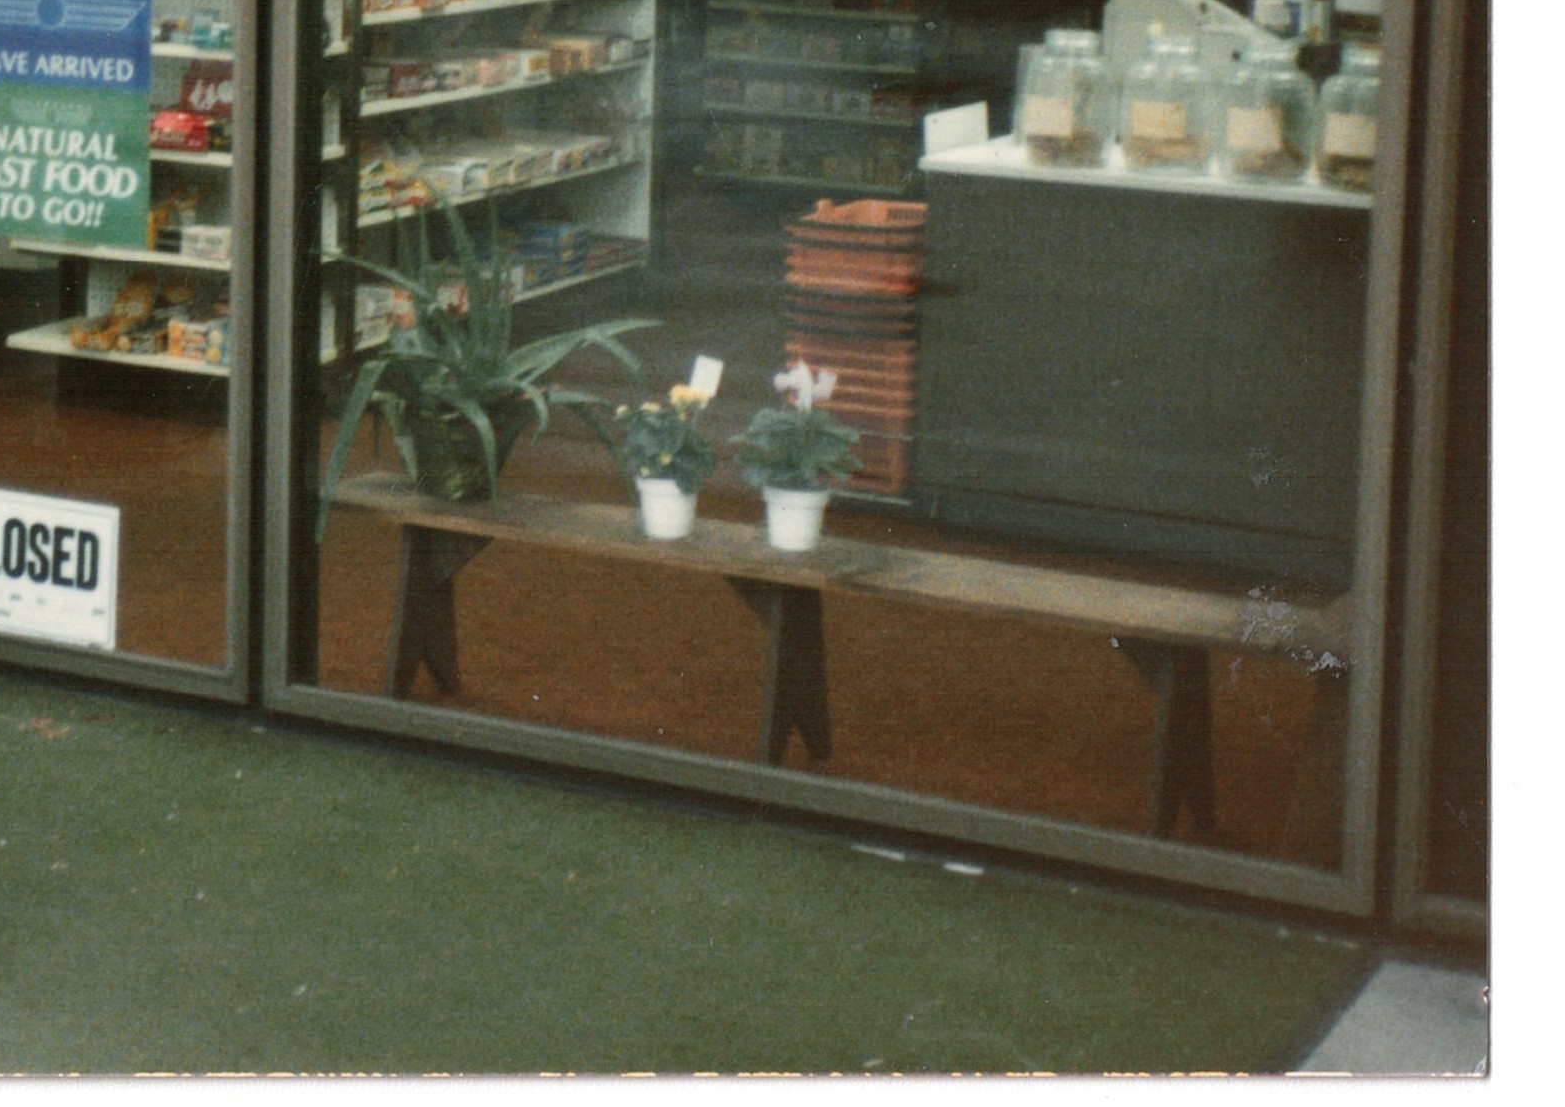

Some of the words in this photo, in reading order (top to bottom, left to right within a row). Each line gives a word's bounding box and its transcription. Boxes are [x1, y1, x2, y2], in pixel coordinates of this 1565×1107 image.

[35, 54, 134, 81] ARRIVED
[43, 161, 139, 198] FOOD
[42, 199, 105, 227] GO!!
